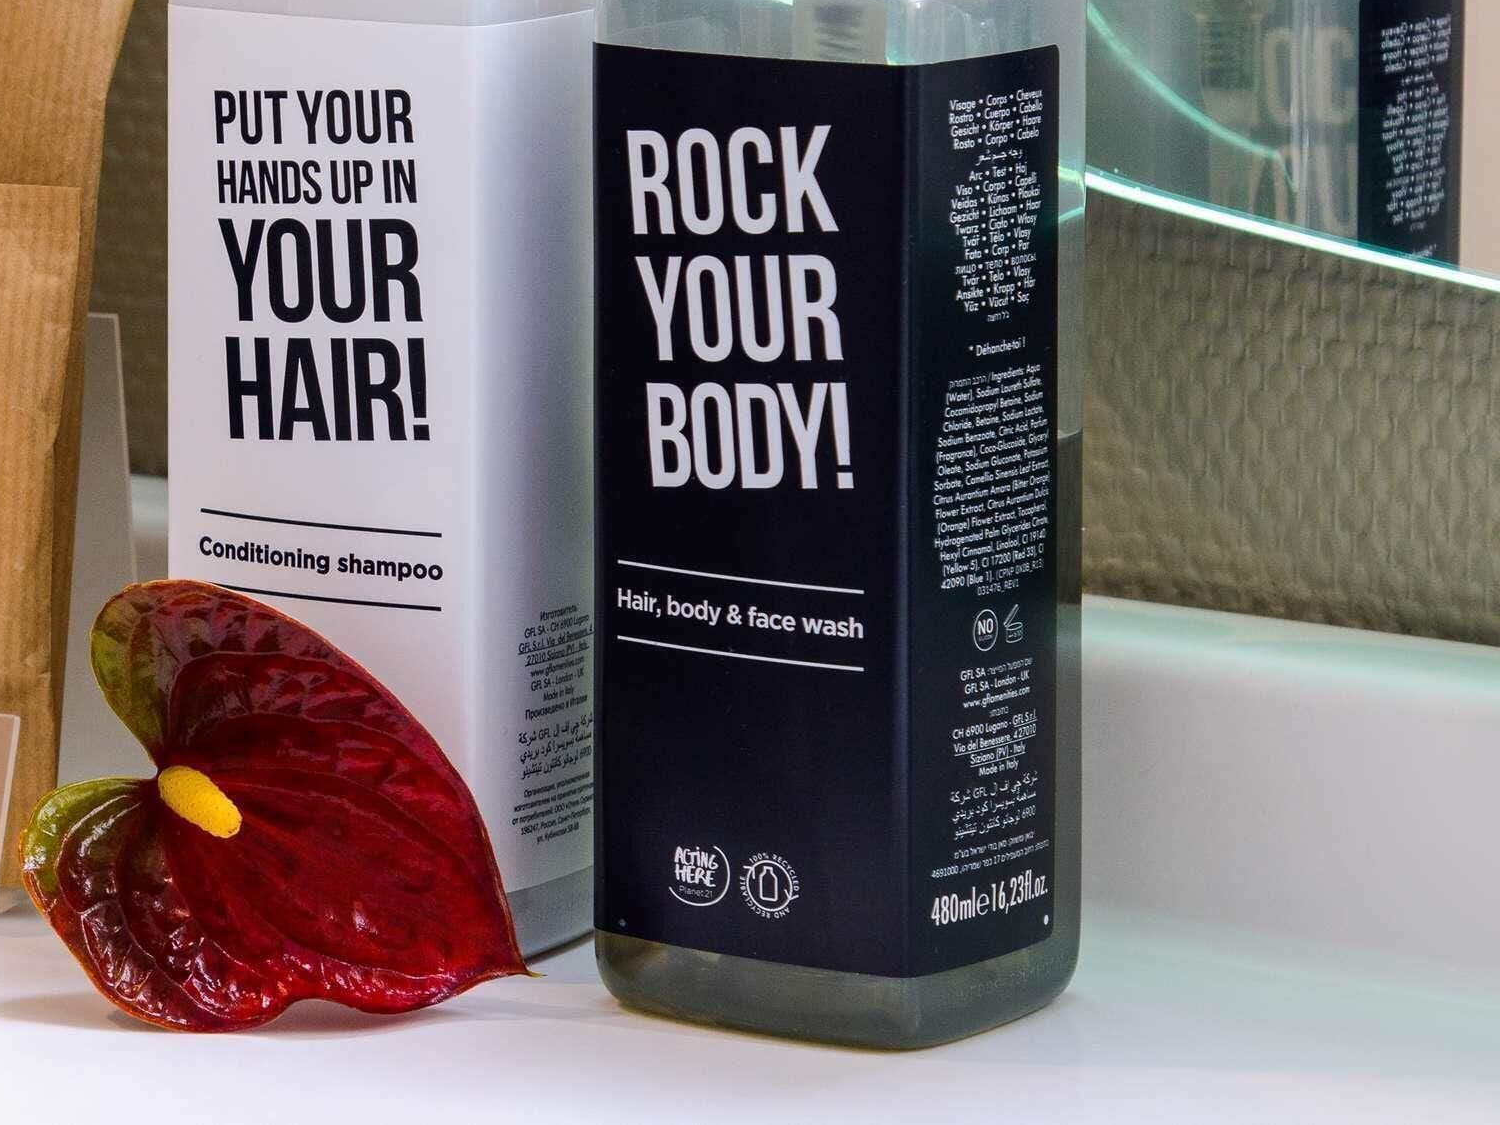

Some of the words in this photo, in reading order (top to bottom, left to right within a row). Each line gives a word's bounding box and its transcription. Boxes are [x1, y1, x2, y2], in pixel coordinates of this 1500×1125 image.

[949, 110, 974, 124] Rostro
[985, 106, 1010, 122] Cuerpo
[1019, 99, 1042, 113] Cabello
[950, 100, 976, 115] Visage
[986, 94, 1007, 110] Corps
[1016, 89, 1042, 101] Cheveux
[214, 89, 288, 144] PUT
[297, 89, 414, 144] YOUR
[951, 123, 979, 137] Gesicht
[990, 119, 1013, 135] Körper
[1023, 115, 1042, 126] Haare
[953, 138, 975, 150] Rosto
[986, 132, 1008, 147] Corpo
[1017, 126, 1039, 140] Cabelo
[217, 159, 321, 204] HANDS
[329, 160, 374, 204] UP
[383, 159, 417, 203] IN
[626, 125, 839, 235] ROCK
[956, 185, 972, 195] Viso
[983, 181, 1005, 195] Corpo
[1015, 172, 1036, 187] Capelli
[969, 171, 982, 181] Arc
[992, 166, 1006, 177] Test
[1016, 162, 1027, 177] Haj
[952, 197, 977, 209] Veidas
[1019, 185, 1040, 199] Plaukai
[950, 209, 979, 223] Gezicht
[990, 205, 1017, 217] Lichaam
[1026, 199, 1041, 210] Haar
[955, 224, 979, 235] Twarz
[1014, 227, 1031, 242] Vlasy
[992, 244, 1009, 256] Corp
[218, 218, 424, 324] YOUR
[989, 270, 1004, 282] Telo
[1013, 266, 1031, 279] Vlasy
[956, 287, 984, 300] Ansikte
[993, 283, 1015, 298] Kropp
[635, 254, 844, 363] YOUR
[964, 301, 979, 312] Yüz
[224, 336, 431, 441] HAIR!
[976, 384, 1000, 398] Sodium
[646, 382, 855, 490] BODY!
[200, 536, 330, 574] Conditioning
[337, 554, 443, 581] shampoo
[617, 587, 661, 617] Hair,
[667, 595, 721, 626] body
[727, 605, 742, 625] &
[748, 606, 796, 631] face
[802, 617, 864, 639] wash
[977, 618, 993, 635] NO
[960, 670, 974, 681] GFL
[976, 668, 986, 678] SA
[964, 683, 977, 694] GFL
[980, 681, 990, 691] SA
[994, 675, 1017, 688] London
[1021, 670, 1030, 681] UK
[952, 729, 963, 739] CH
[965, 724, 984, 737] 6900
[986, 721, 1008, 733] Lugano
[1013, 714, 1024, 725] GFL
[954, 743, 966, 755] Via
[968, 739, 978, 752] del
[970, 753, 994, 766] Siziano
[979, 764, 997, 776] Made
[999, 762, 1005, 771] in
[1007, 758, 1019, 770] Italy
[973, 787, 988, 798] GFL
[674, 846, 719, 870] ACTING
[675, 863, 716, 887] HERE
